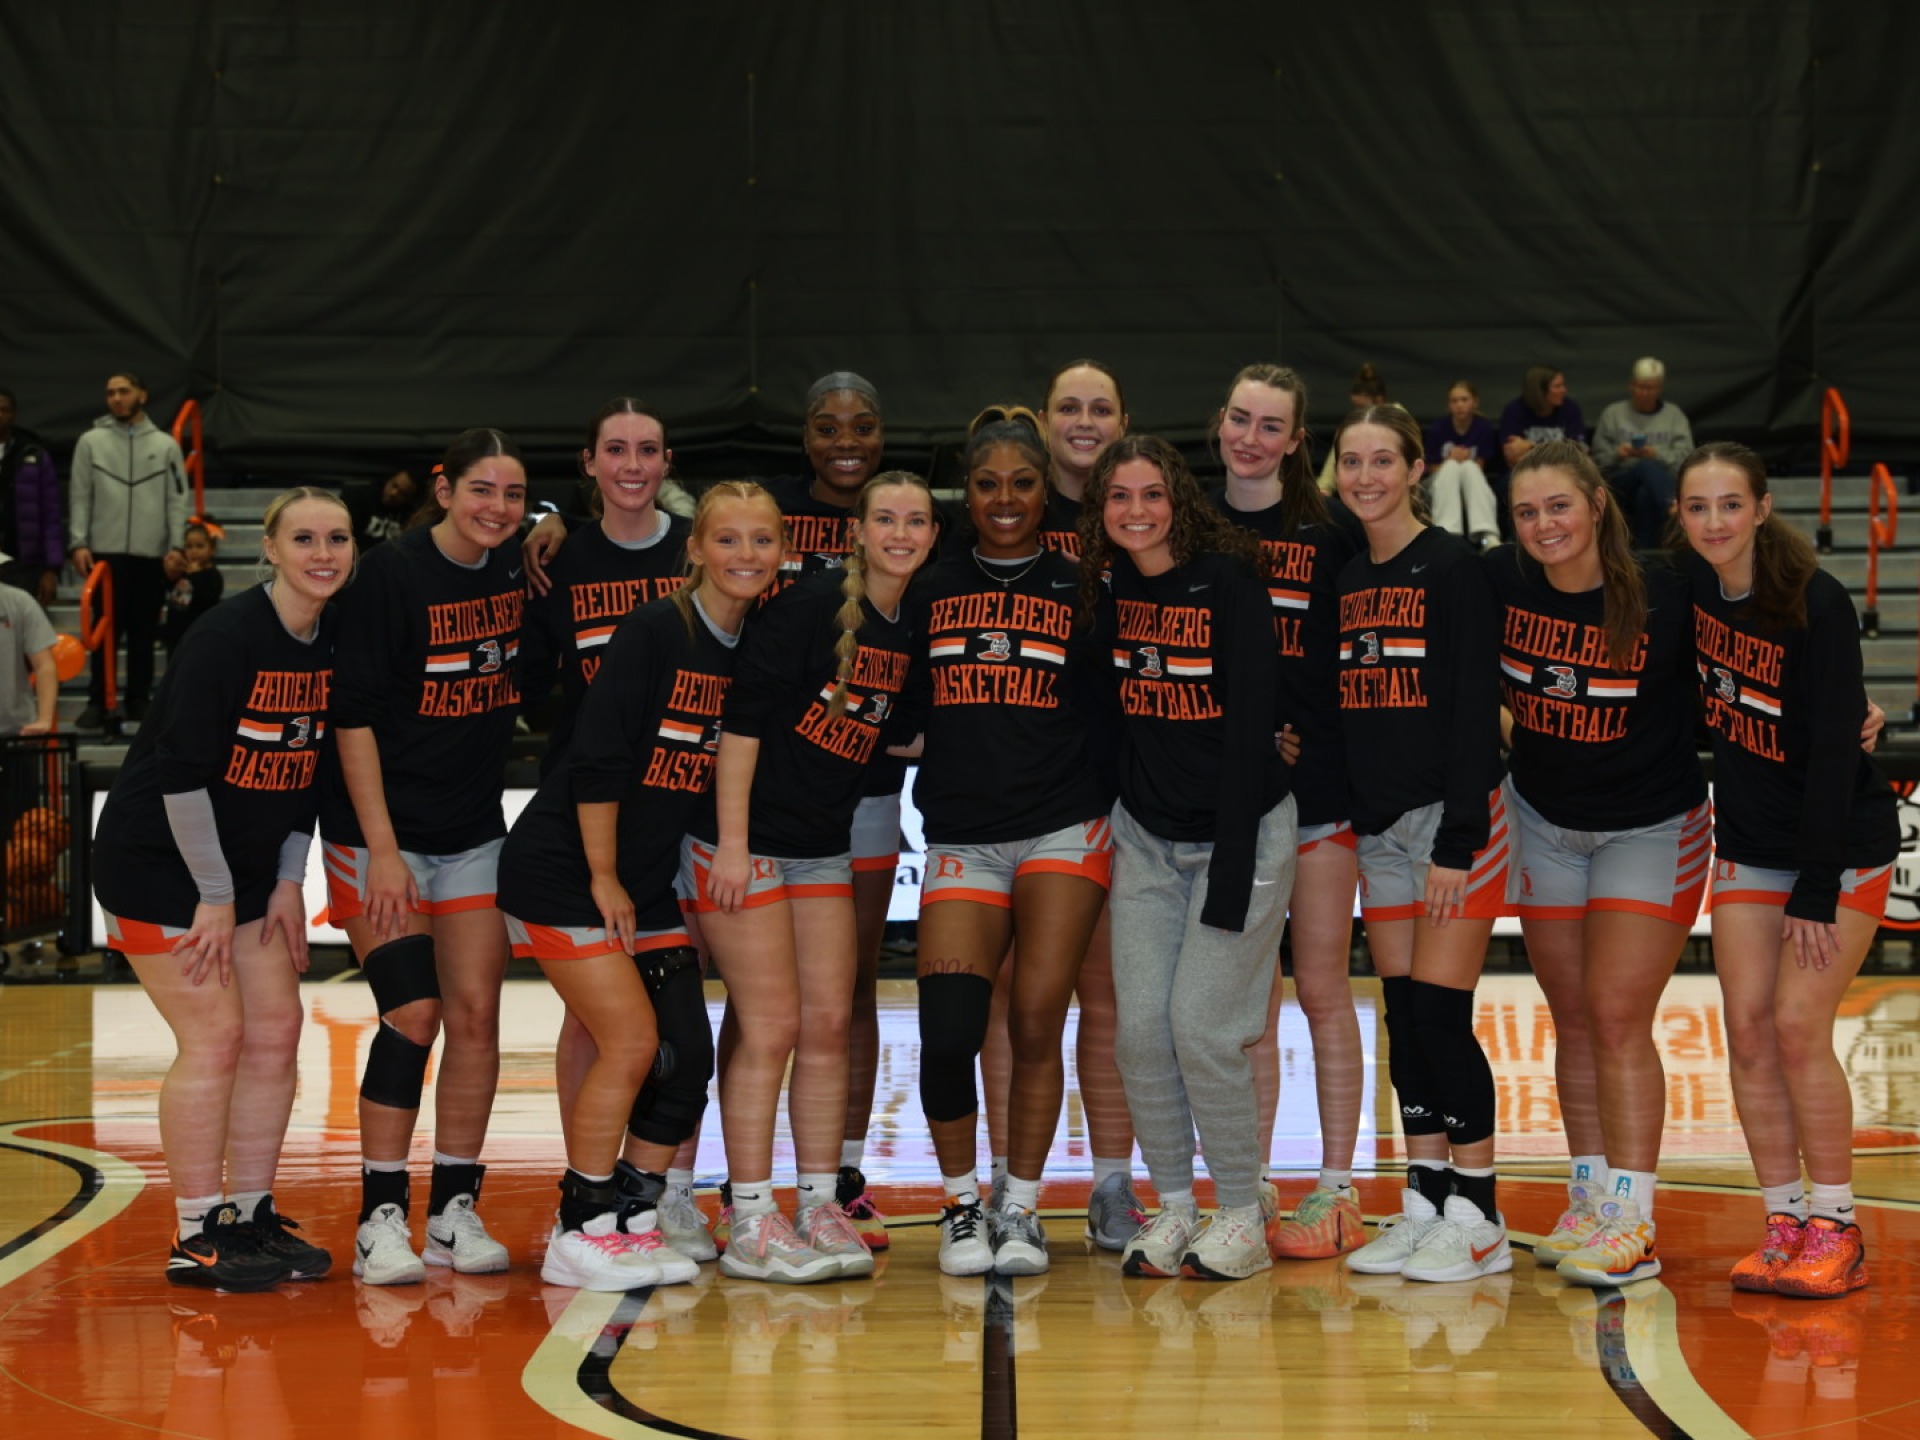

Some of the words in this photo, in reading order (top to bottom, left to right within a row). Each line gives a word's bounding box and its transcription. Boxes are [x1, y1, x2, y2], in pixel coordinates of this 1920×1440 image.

[928, 591, 1073, 641] HEIDELBERG
[1339, 667, 1428, 709] SKETBALL
[224, 744, 319, 791] BASKETB
